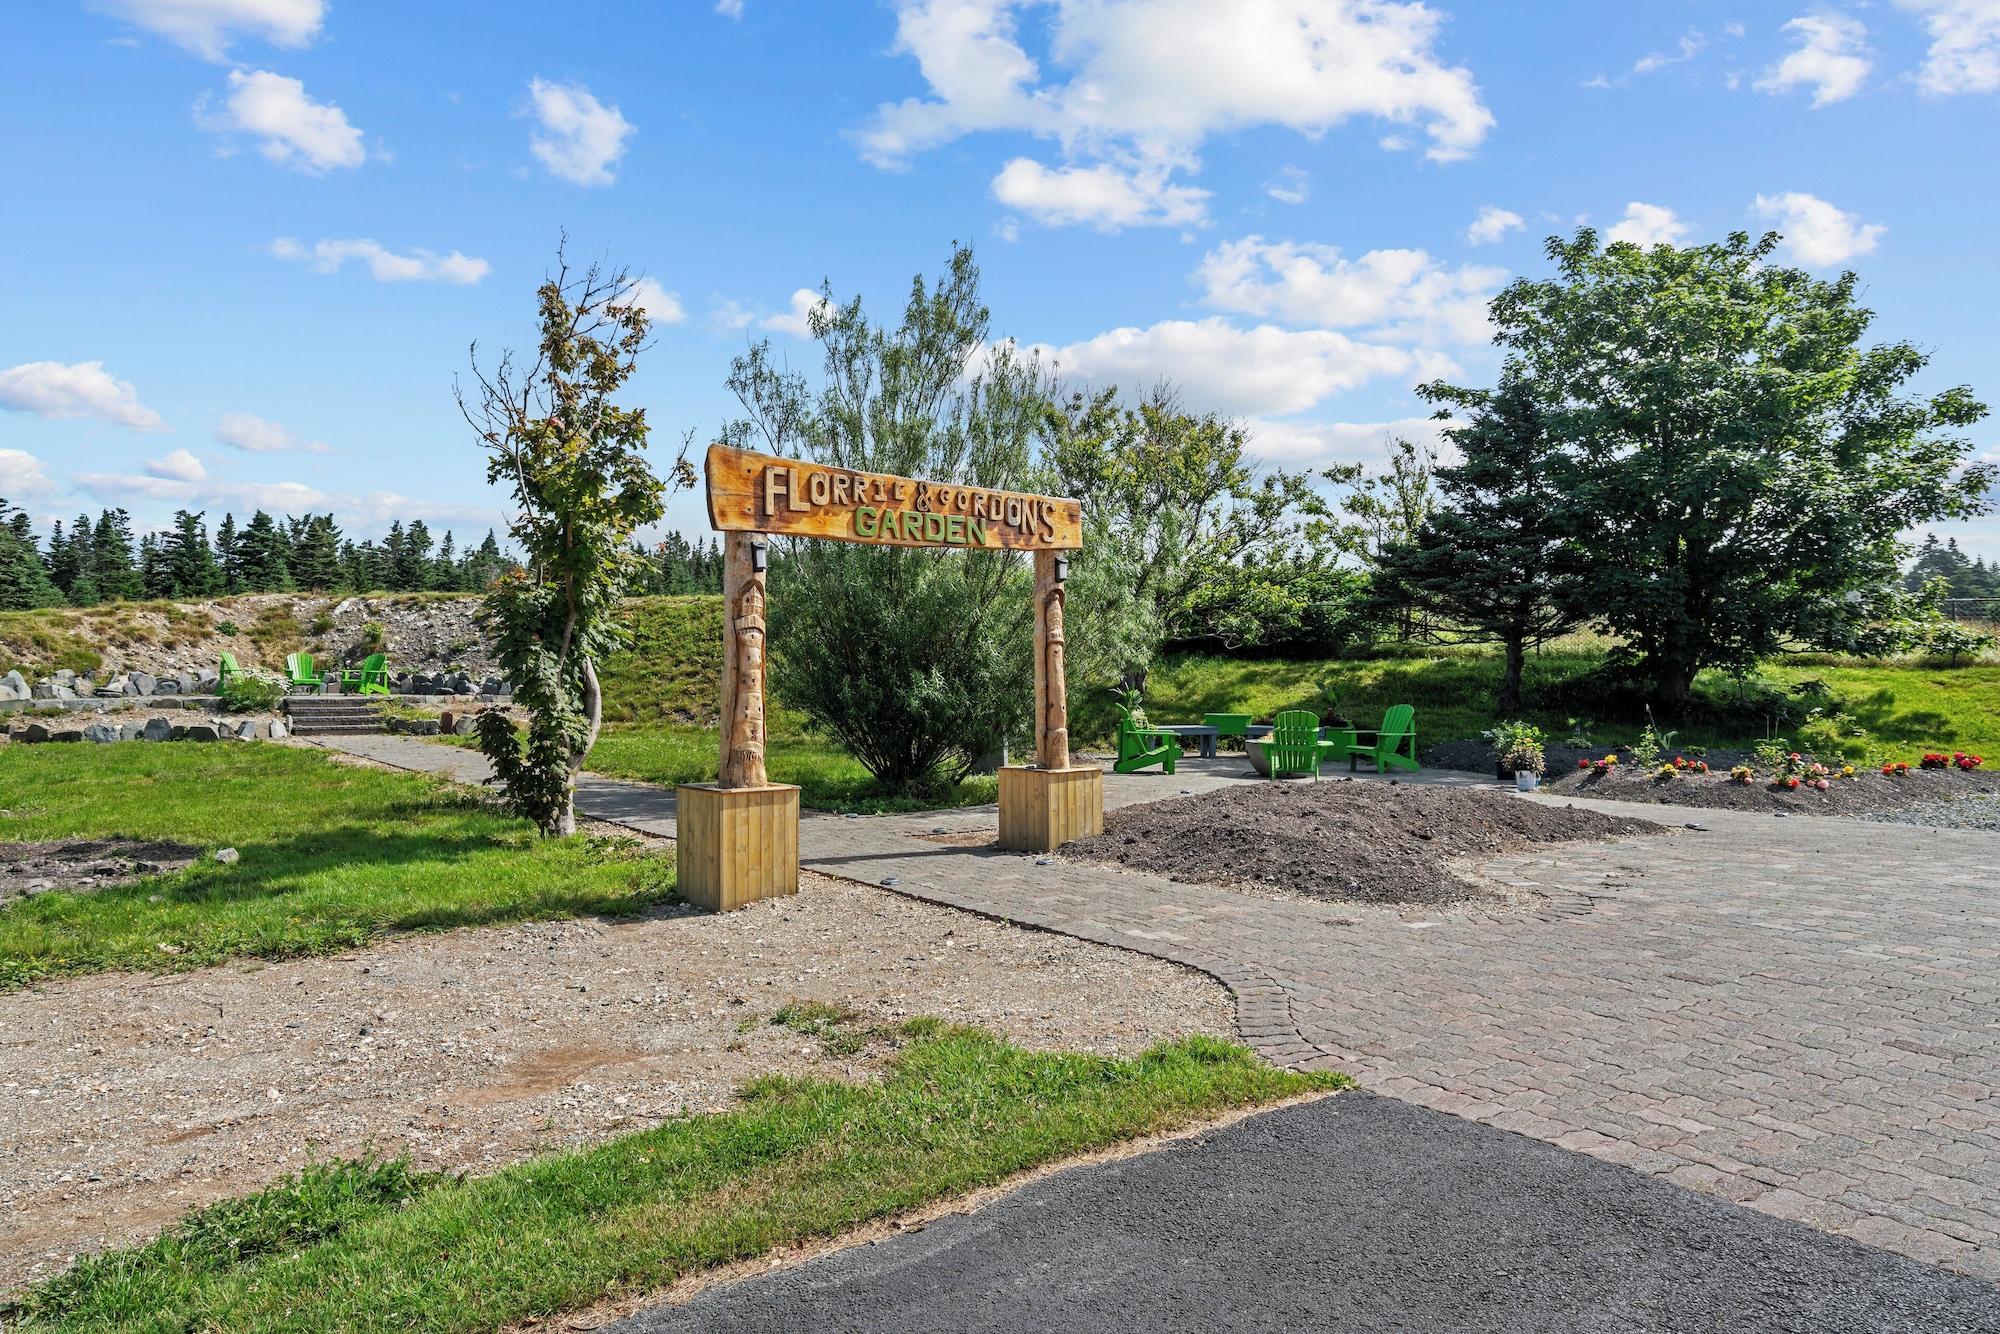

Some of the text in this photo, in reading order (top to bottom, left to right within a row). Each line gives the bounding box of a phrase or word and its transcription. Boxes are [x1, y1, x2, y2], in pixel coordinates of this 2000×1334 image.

[765, 466, 906, 515] FLORRIE
[916, 481, 933, 512] &
[855, 506, 986, 545] GARDEN
